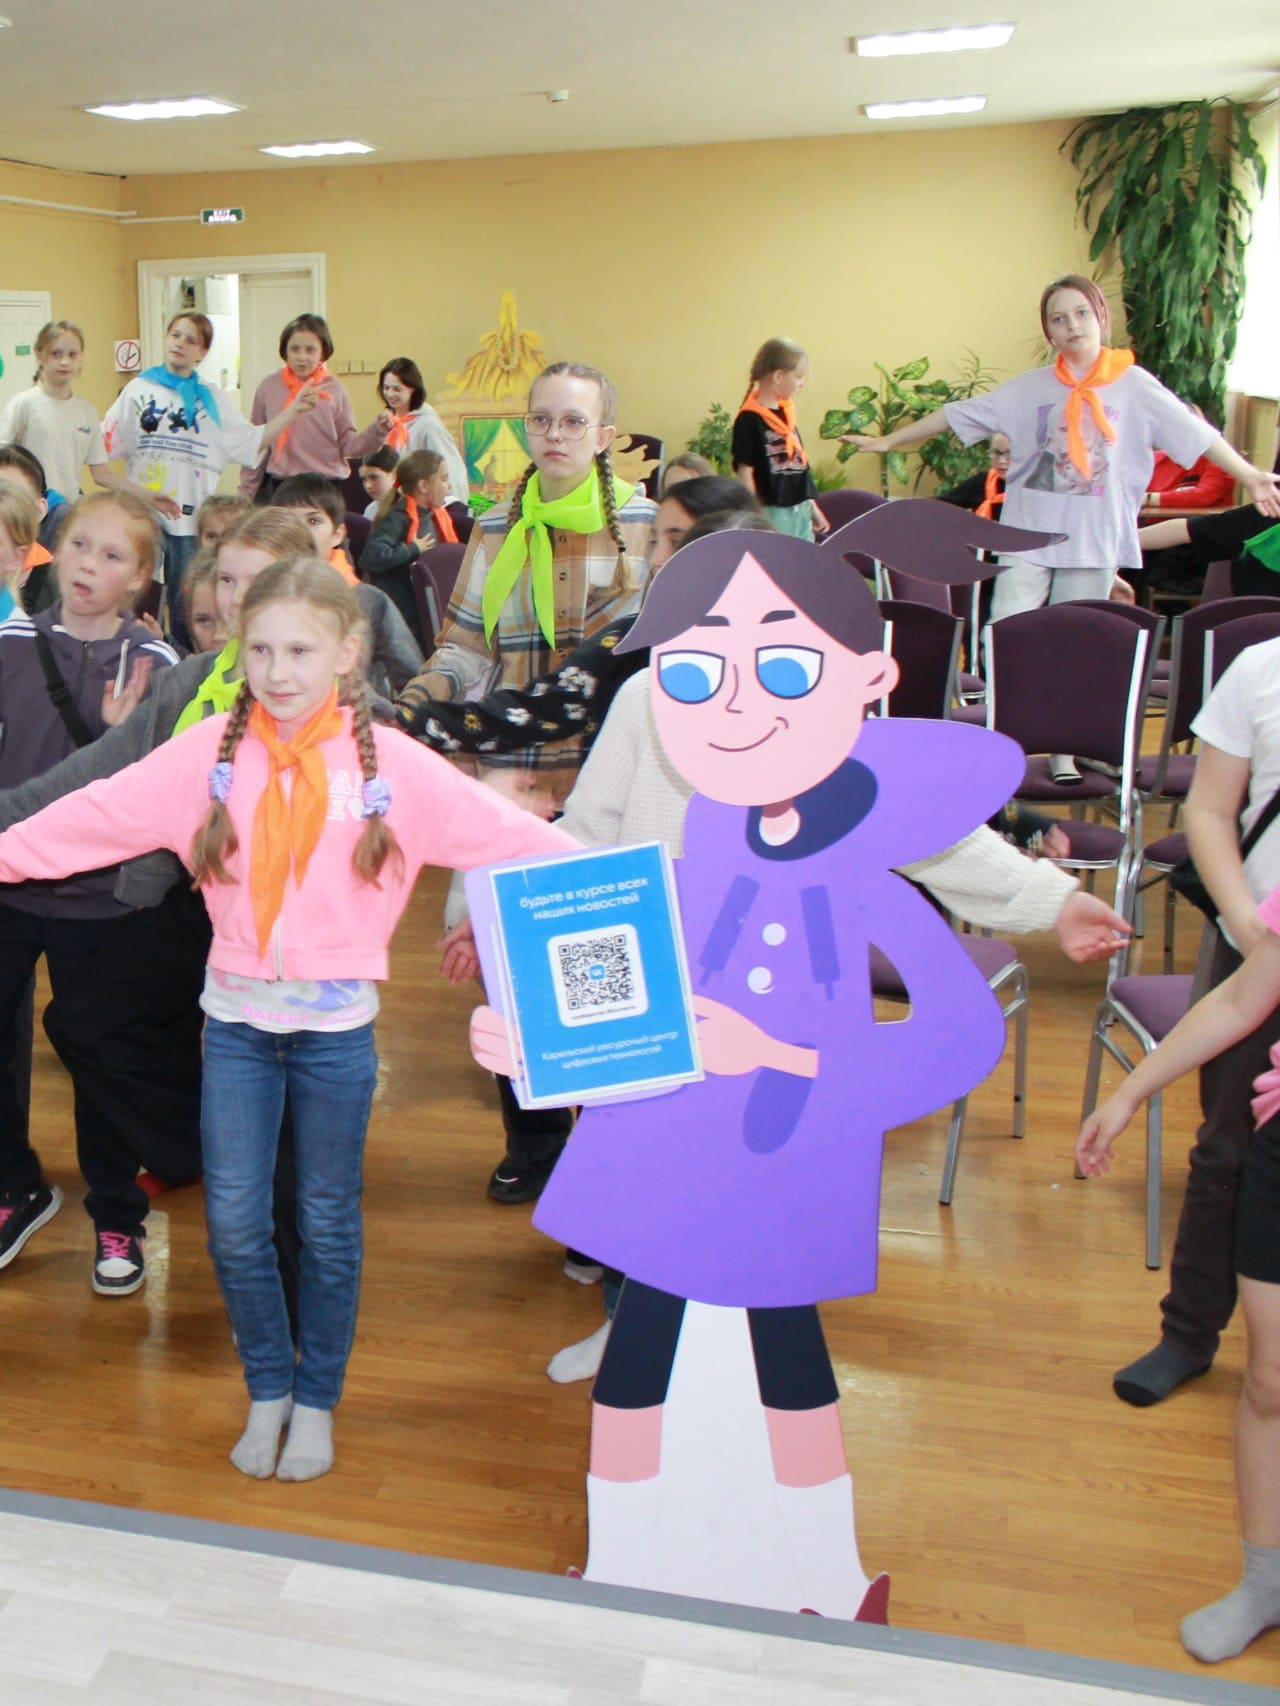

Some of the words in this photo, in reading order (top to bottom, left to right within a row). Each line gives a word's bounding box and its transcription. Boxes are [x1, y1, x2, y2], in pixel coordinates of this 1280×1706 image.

[520, 892, 564, 909] будьте
[566, 891, 575, 900] в
[576, 884, 616, 899] курсе
[617, 877, 648, 890] всех
[533, 905, 575, 920] наших
[577, 891, 639, 912] новостей
